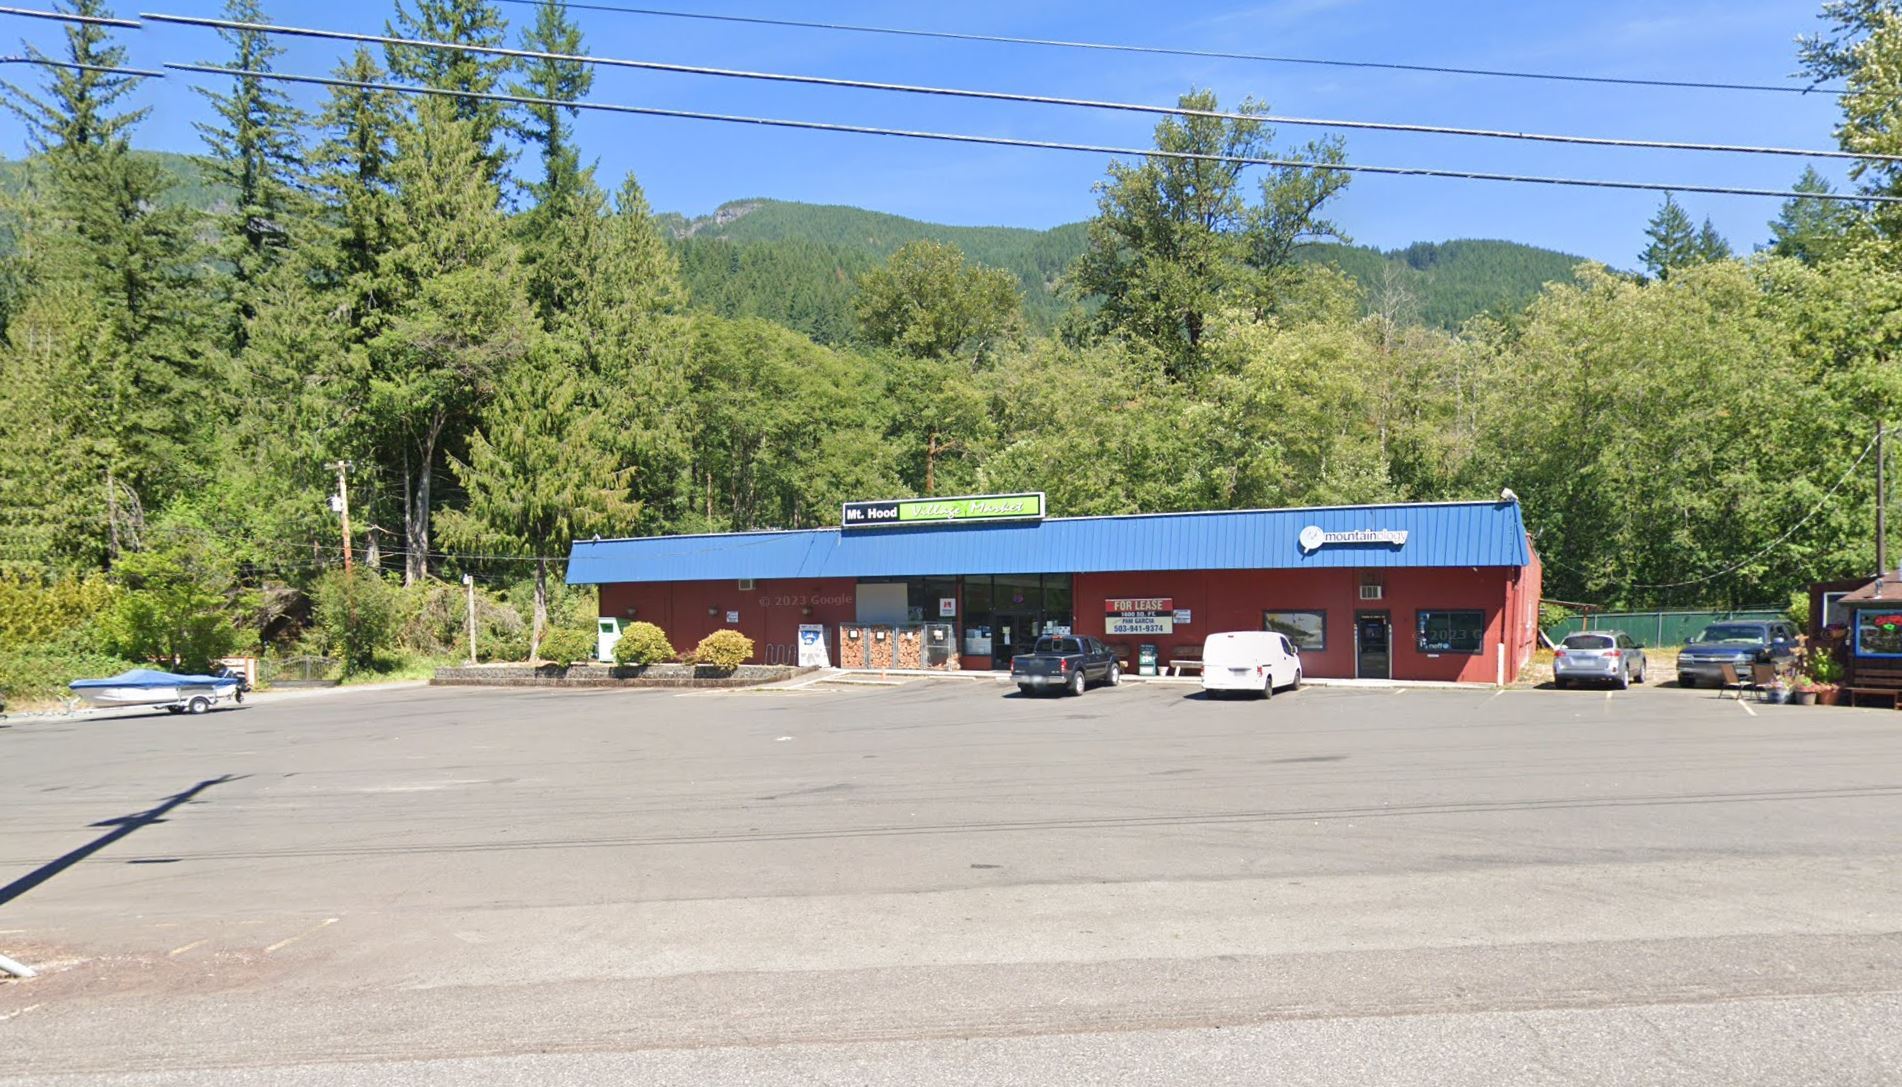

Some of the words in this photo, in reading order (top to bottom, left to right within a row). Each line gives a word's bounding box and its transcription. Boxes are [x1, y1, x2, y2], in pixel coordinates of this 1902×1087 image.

[847, 508, 864, 520] Mt.
[868, 507, 897, 519] Hood
[912, 502, 960, 519] Village
[970, 499, 1023, 514] Market
[1325, 530, 1406, 543] mountainology
[1114, 601, 1132, 610] FOR
[1135, 600, 1163, 610] LEASE
